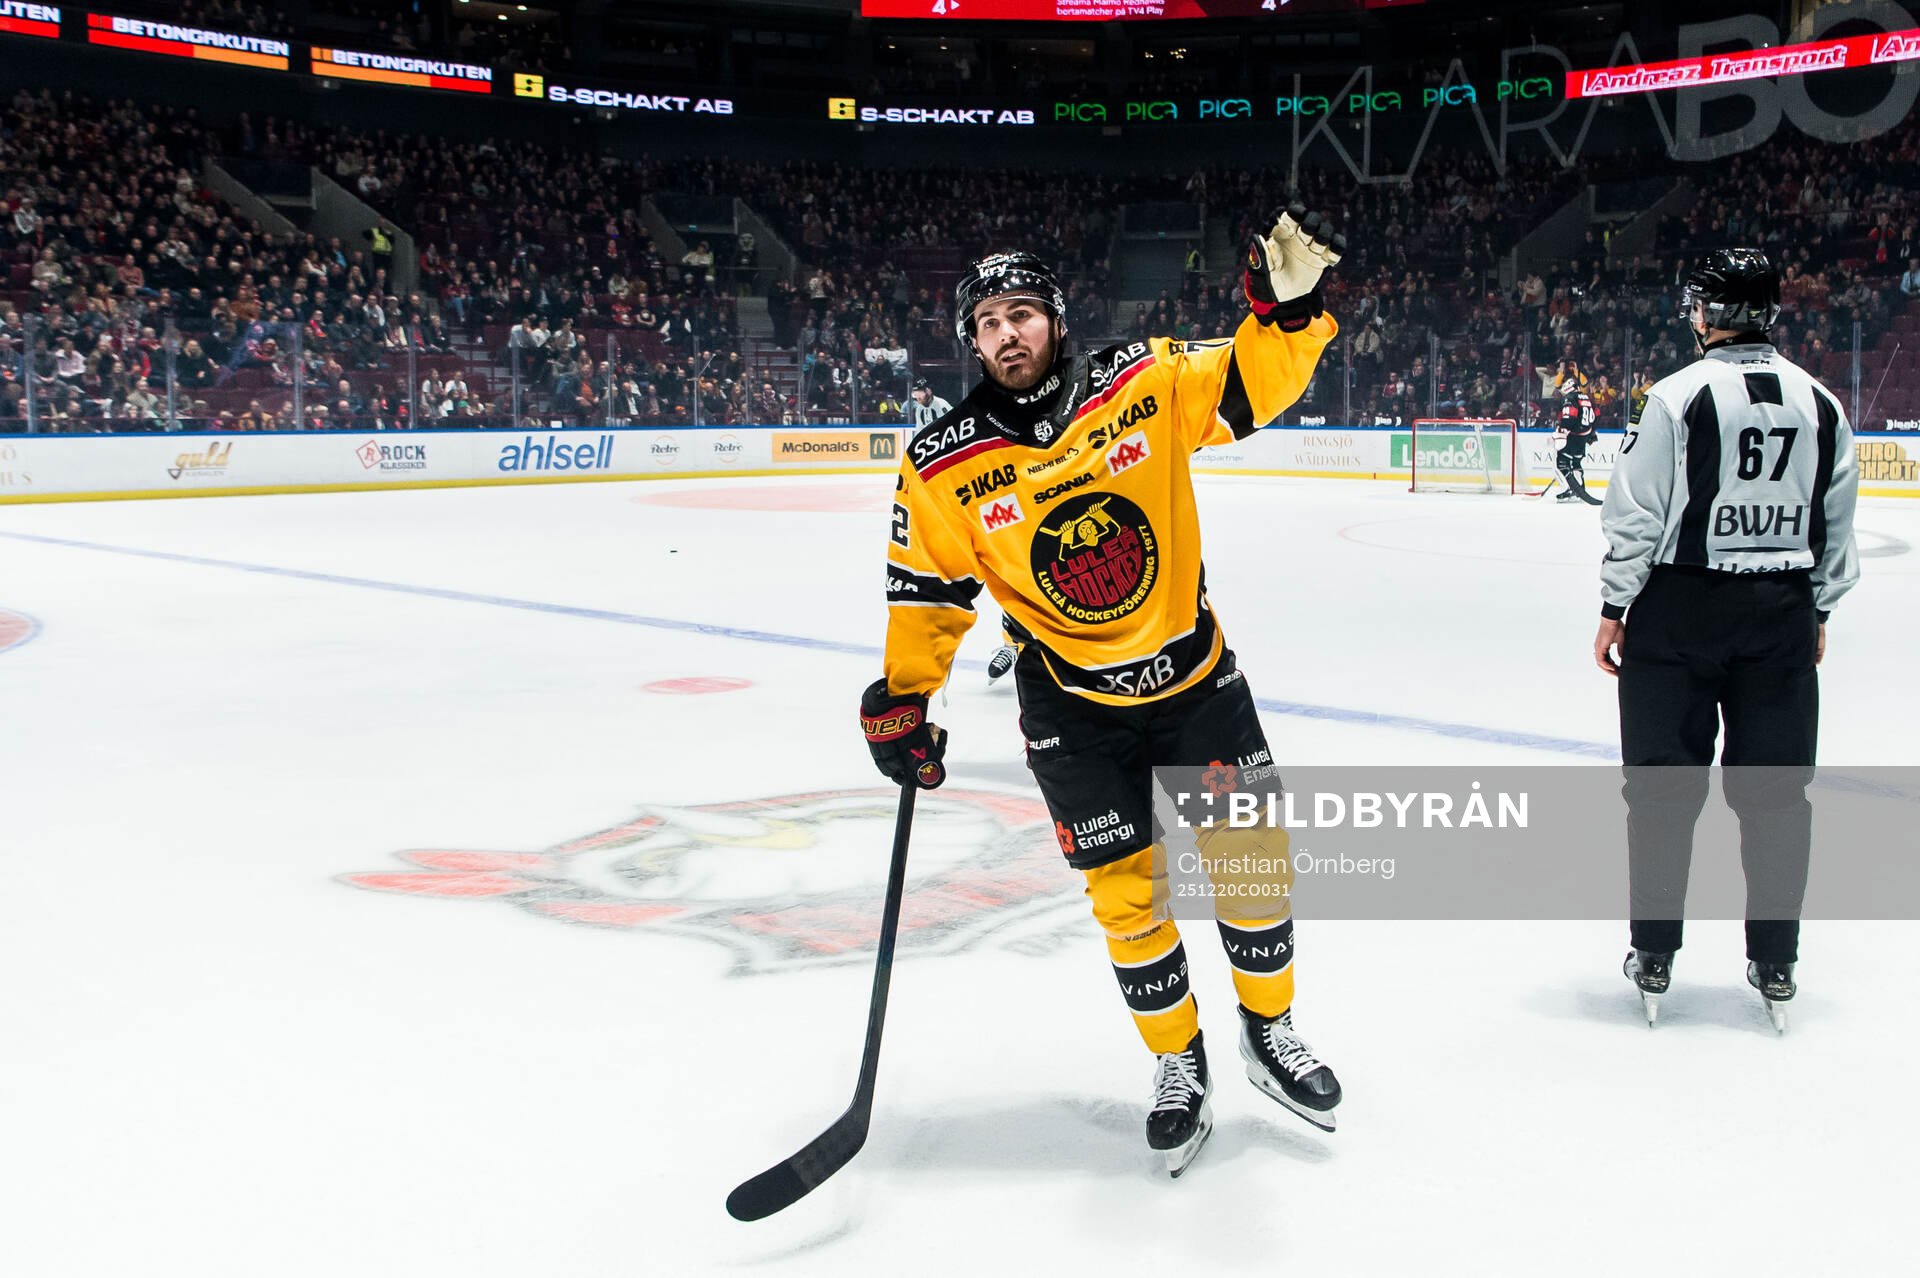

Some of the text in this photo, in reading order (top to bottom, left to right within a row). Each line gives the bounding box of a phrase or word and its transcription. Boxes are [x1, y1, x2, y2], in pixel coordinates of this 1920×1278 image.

[1056, 7, 1113, 16] bortamatcher
[1128, 6, 1145, 15] TV4
[1146, 5, 1164, 16] Play
[112, 16, 289, 56] BETONGAKUTEN
[332, 49, 493, 81] BETONGAKUTEN
[1588, 45, 1847, 93] Andreaz Transport
[548, 86, 734, 114] S-SCHAKT AB
[860, 107, 1035, 125] S-SCHAKT AB
[979, 263, 1008, 279] kry
[1090, 341, 1147, 388] SSAB
[1029, 374, 1061, 403] LKAB
[1108, 394, 1159, 441] LKAB
[380, 445, 427, 461] ROCK
[498, 434, 615, 472] ahlsell
[781, 441, 860, 453] McDonald's
[913, 416, 977, 466] SSAB
[1108, 440, 1148, 474] MAX
[1737, 426, 1799, 482] 67
[971, 462, 1018, 499] LKAB
[1027, 460, 1055, 476] NIEMI
[1033, 471, 1096, 505] SCANIA
[982, 501, 1018, 531] MAX
[1713, 504, 1804, 537] BWH
[1050, 525, 1140, 583] LULEÅ
[1037, 524, 1156, 622] LULEÅ HOCKEYFÖRENING 1977
[1057, 545, 1143, 607] HOCKEY
[1028, 735, 1061, 751] AUER
[1073, 808, 1121, 836] Luleå
[1077, 823, 1136, 850] Energi
